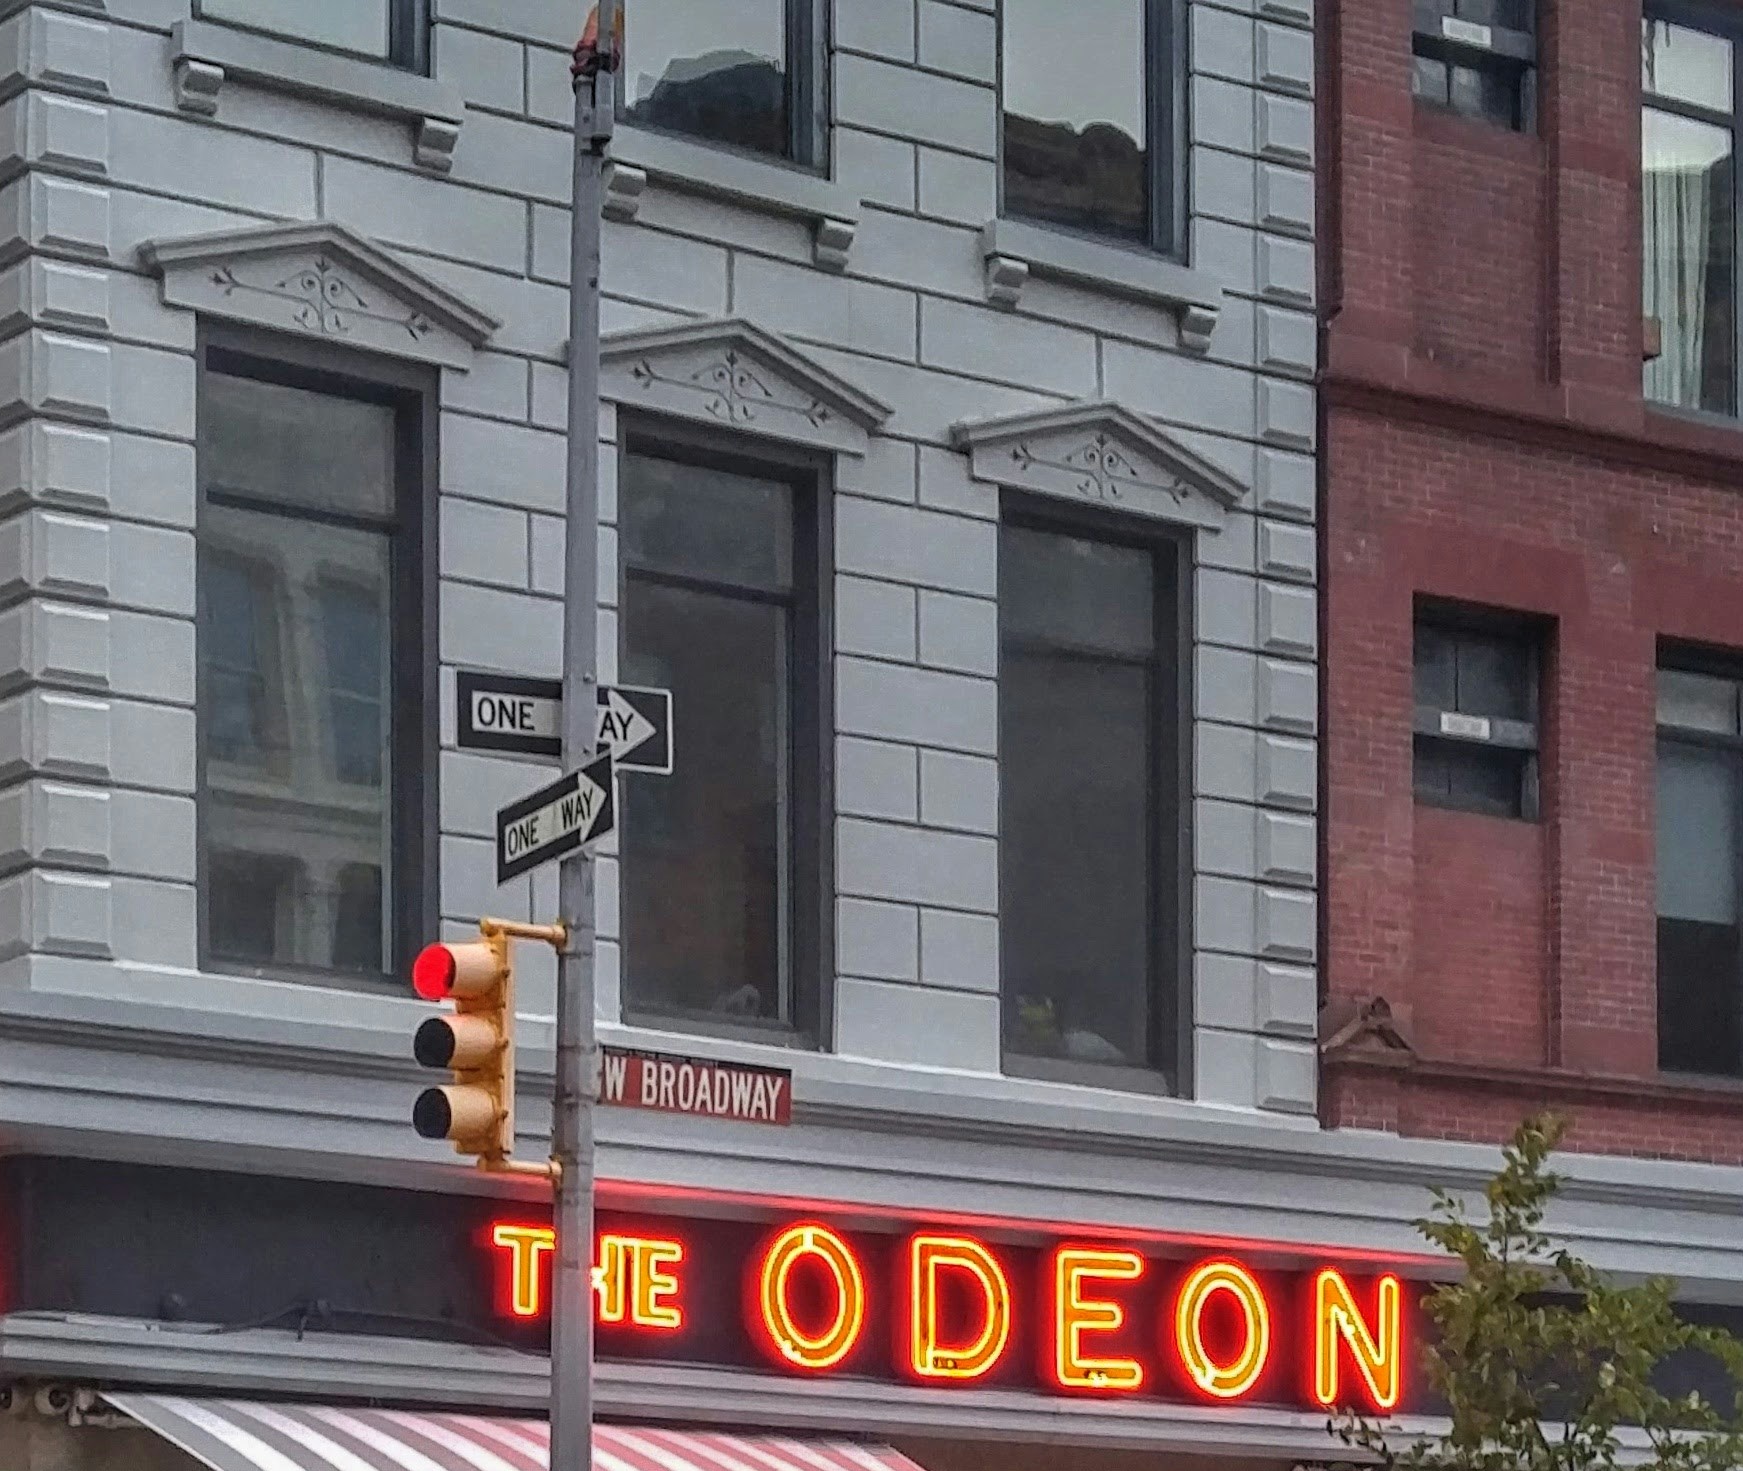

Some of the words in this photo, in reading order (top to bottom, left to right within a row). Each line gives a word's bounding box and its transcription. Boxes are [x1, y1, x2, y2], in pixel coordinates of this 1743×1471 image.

[477, 697, 535, 731] ONE
[599, 710, 634, 741] AY
[508, 815, 539, 856] ONE
[562, 787, 593, 830] WAY
[606, 1055, 627, 1101] W
[641, 1060, 783, 1121] BROADWAY
[761, 1226, 1400, 1408] ODEON
